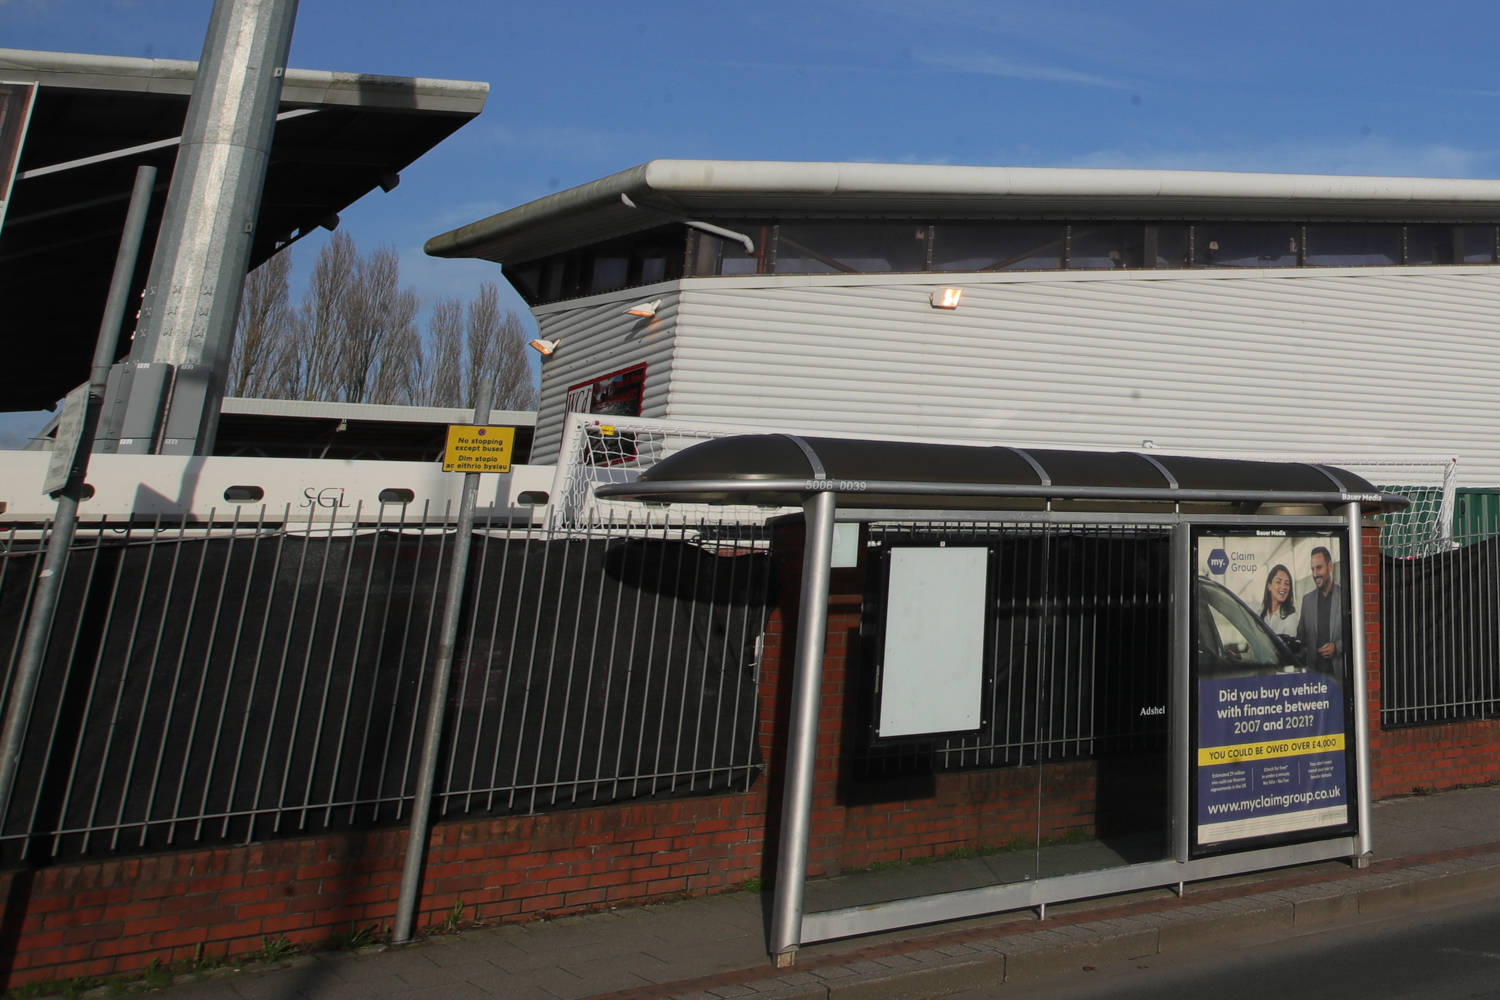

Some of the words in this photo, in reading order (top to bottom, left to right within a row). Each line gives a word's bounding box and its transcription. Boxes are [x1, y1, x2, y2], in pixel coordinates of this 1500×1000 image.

[1361, 494, 1382, 502] Media
[1230, 551, 1255, 561] Claim
[1231, 563, 1258, 573] Group
[1219, 689, 1238, 702] Did
[1239, 690, 1258, 703] you
[1260, 686, 1280, 700] buy
[1282, 688, 1290, 697] a
[1291, 682, 1328, 696] vehicle
[1139, 705, 1166, 717] Adshel
[1217, 706, 1241, 719] with
[1243, 704, 1282, 717] finance
[1284, 700, 1330, 713] between
[1234, 720, 1261, 734] 2007
[1263, 718, 1284, 731] and
[1285, 714, 1314, 729] 2021?
[1209, 751, 1226, 760] YOU
[1227, 748, 1253, 758] COULD
[1255, 747, 1263, 755] BE
[1266, 744, 1289, 754] OWED
[1291, 740, 1310, 750] OVER
[1312, 738, 1337, 749] £4,000
[1207, 785, 1341, 815] www.myclaimgroup.co.uk
